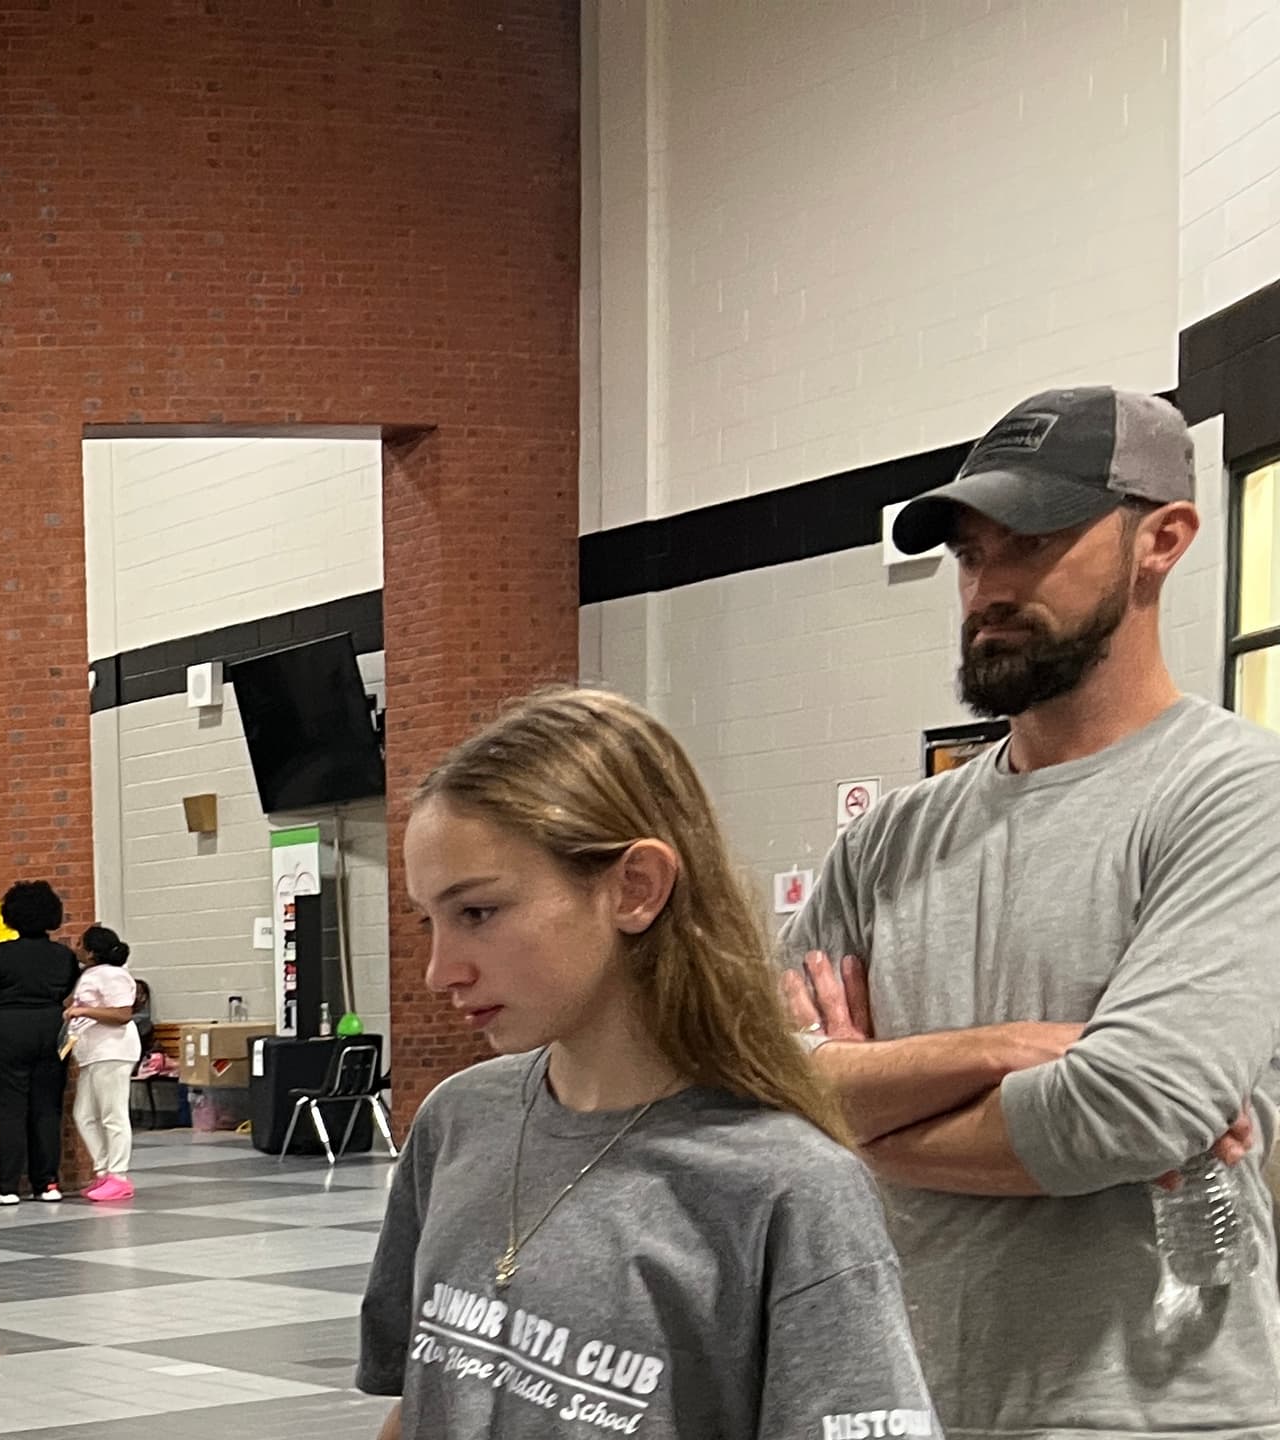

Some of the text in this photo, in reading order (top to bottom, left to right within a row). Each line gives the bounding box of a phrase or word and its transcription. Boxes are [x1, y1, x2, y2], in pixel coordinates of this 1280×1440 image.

[422, 1283, 509, 1338] JUNIOR
[576, 1340, 664, 1395] CLUB
[560, 1393, 644, 1435] School
